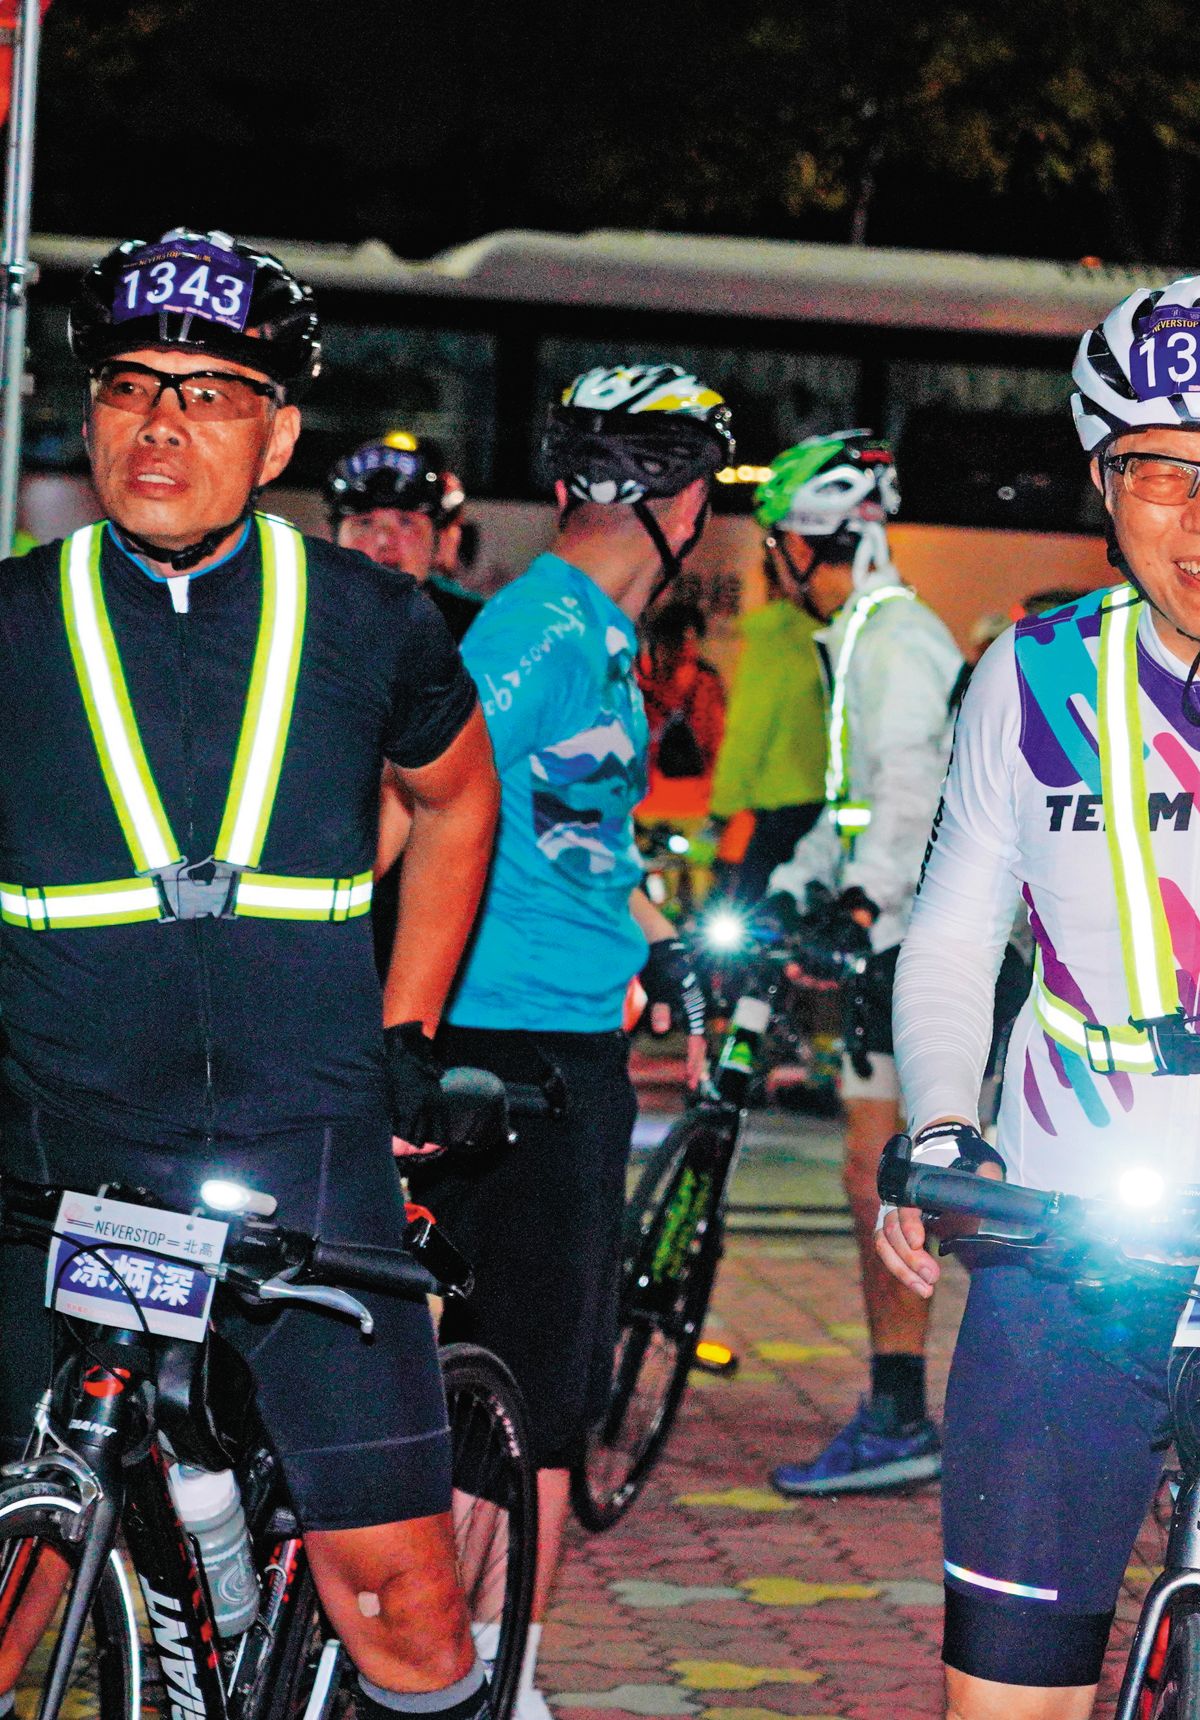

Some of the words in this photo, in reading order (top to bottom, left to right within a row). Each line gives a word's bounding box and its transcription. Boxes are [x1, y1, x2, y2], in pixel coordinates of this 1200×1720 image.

[124, 262, 244, 316] 1343
[1046, 792, 1195, 832] TEM
[95, 1219, 166, 1247] NEVERSTOP
[183, 1239, 215, 1257] 北高
